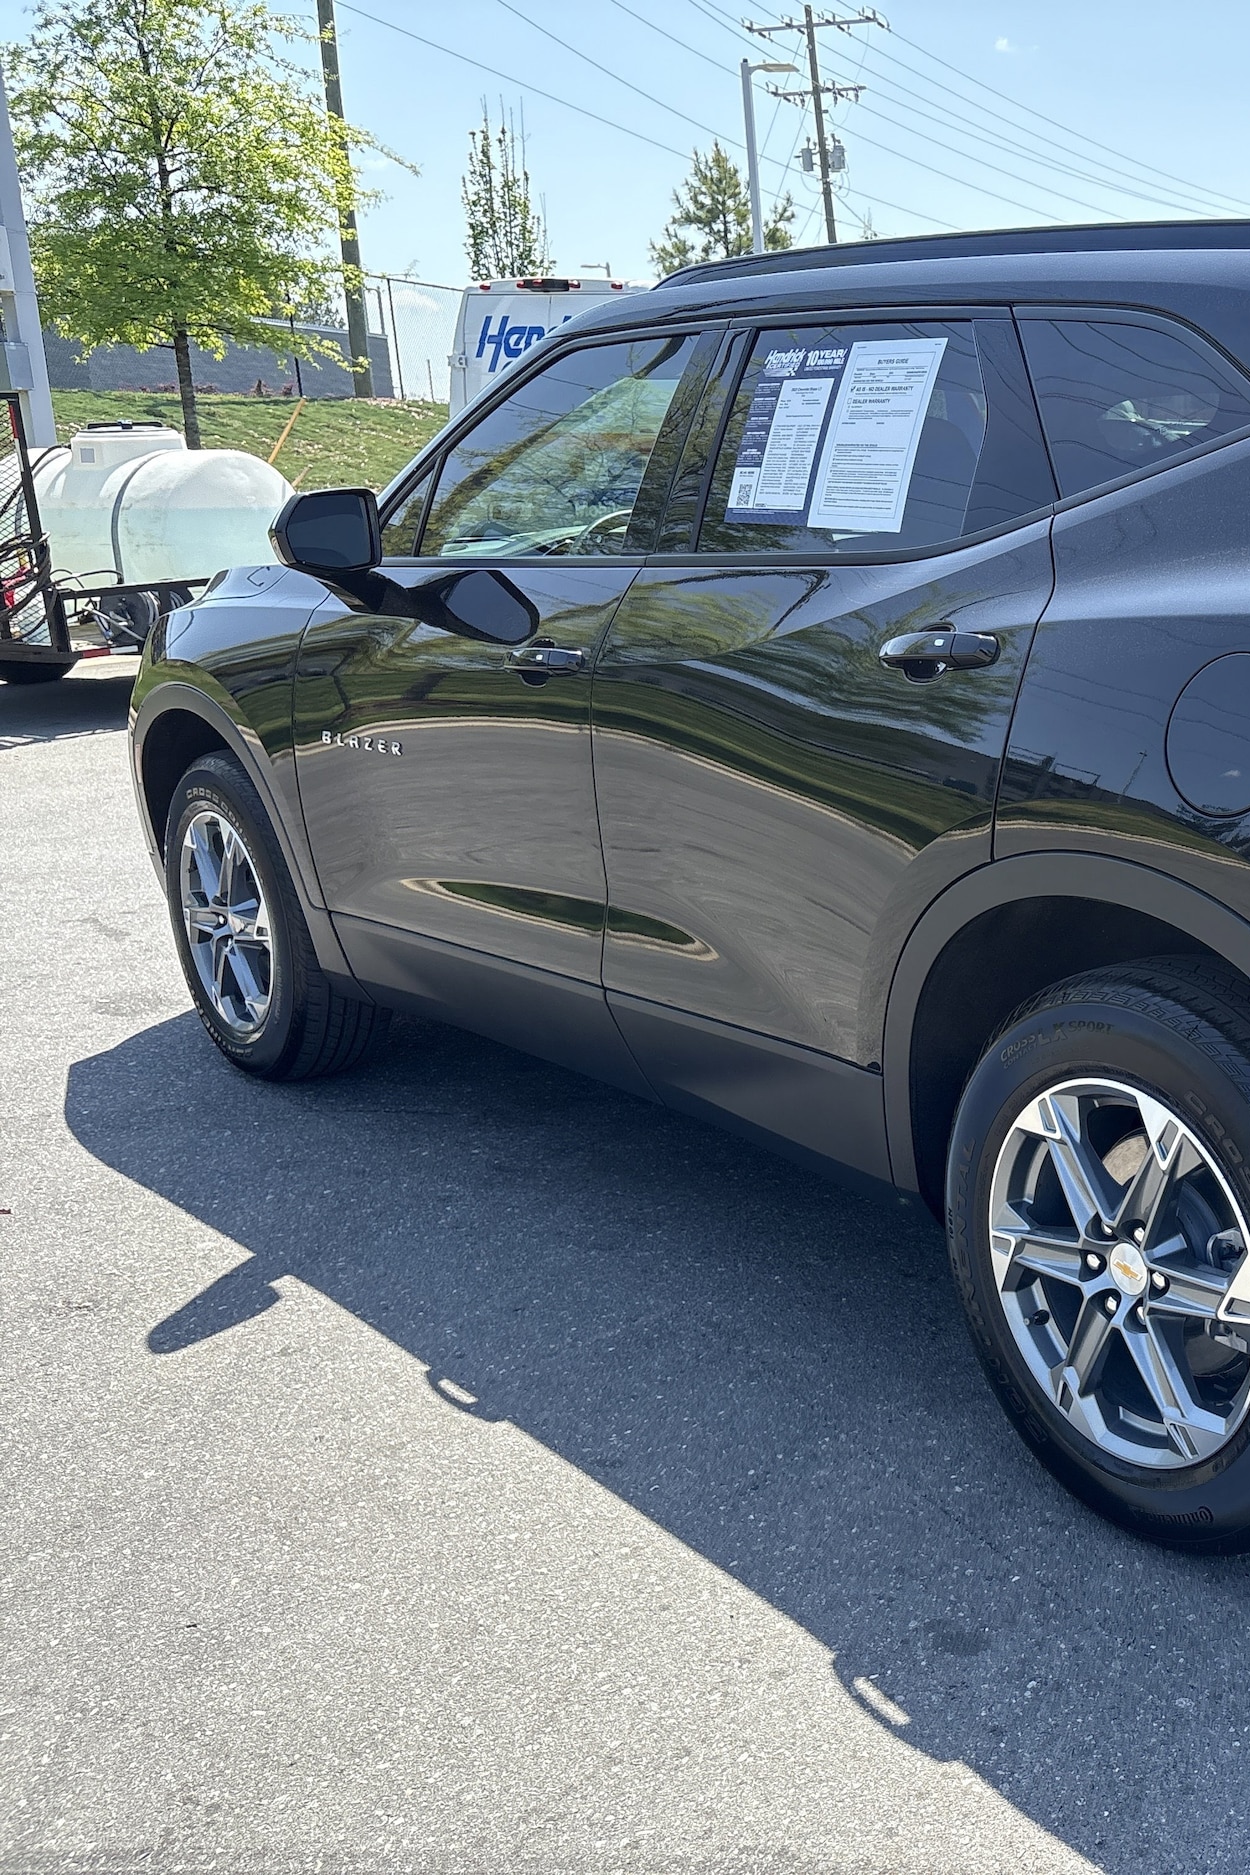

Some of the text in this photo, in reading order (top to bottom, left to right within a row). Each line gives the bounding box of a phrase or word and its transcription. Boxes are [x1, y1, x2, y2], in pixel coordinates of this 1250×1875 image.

[764, 348, 807, 369] Hendrick
[806, 350, 820, 367] 10
[321, 730, 402, 756] BLAZER
[1000, 1033, 1036, 1063] CROSS
[1067, 1020, 1115, 1035] SPORT
[1003, 1043, 1038, 1070] CONTACT
